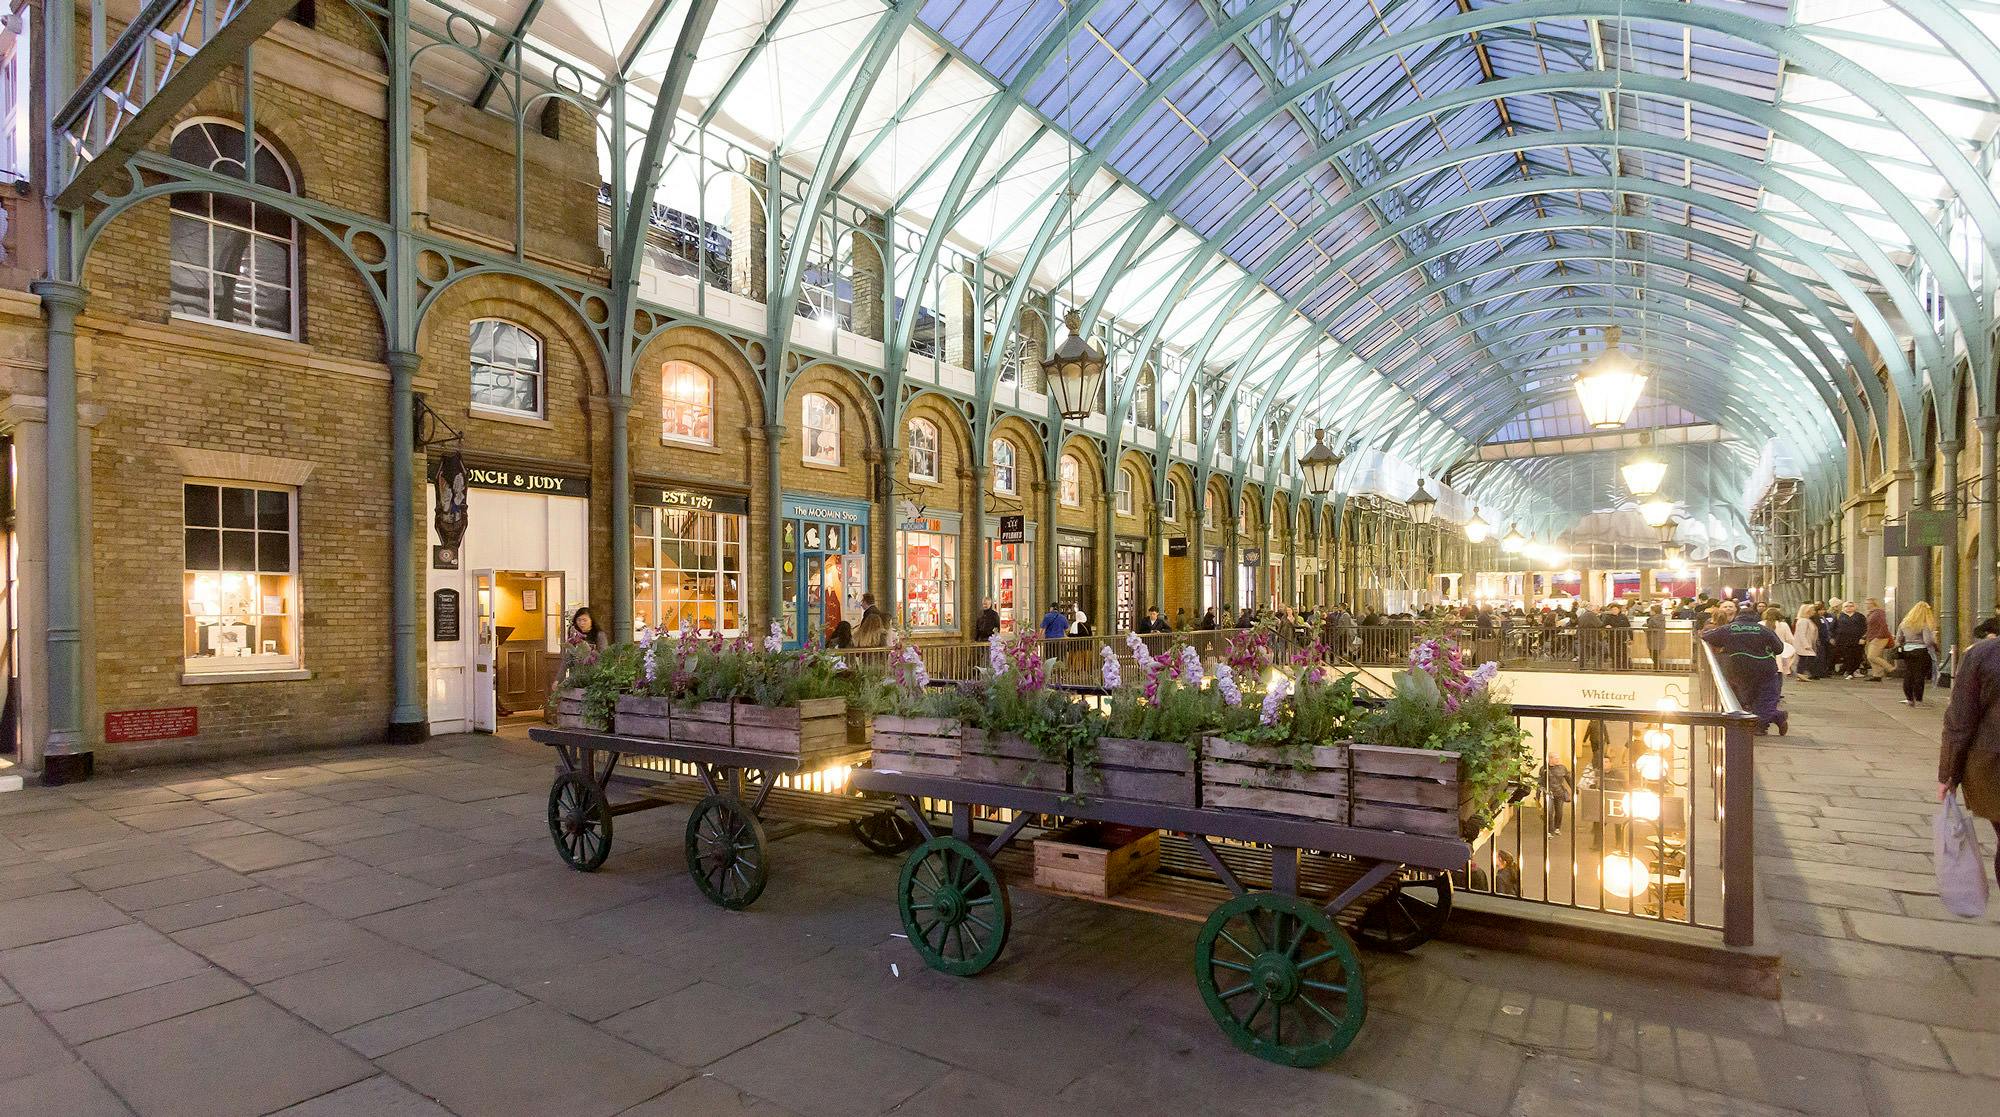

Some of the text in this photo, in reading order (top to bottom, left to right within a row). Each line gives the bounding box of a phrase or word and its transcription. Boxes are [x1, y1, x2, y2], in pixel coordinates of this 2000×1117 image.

[468, 469, 564, 490] NCH & JUDY
[691, 496, 713, 509] 1787
[794, 506, 858, 522] The MOOMIN Shop
[1582, 689, 1635, 701] Whittard
